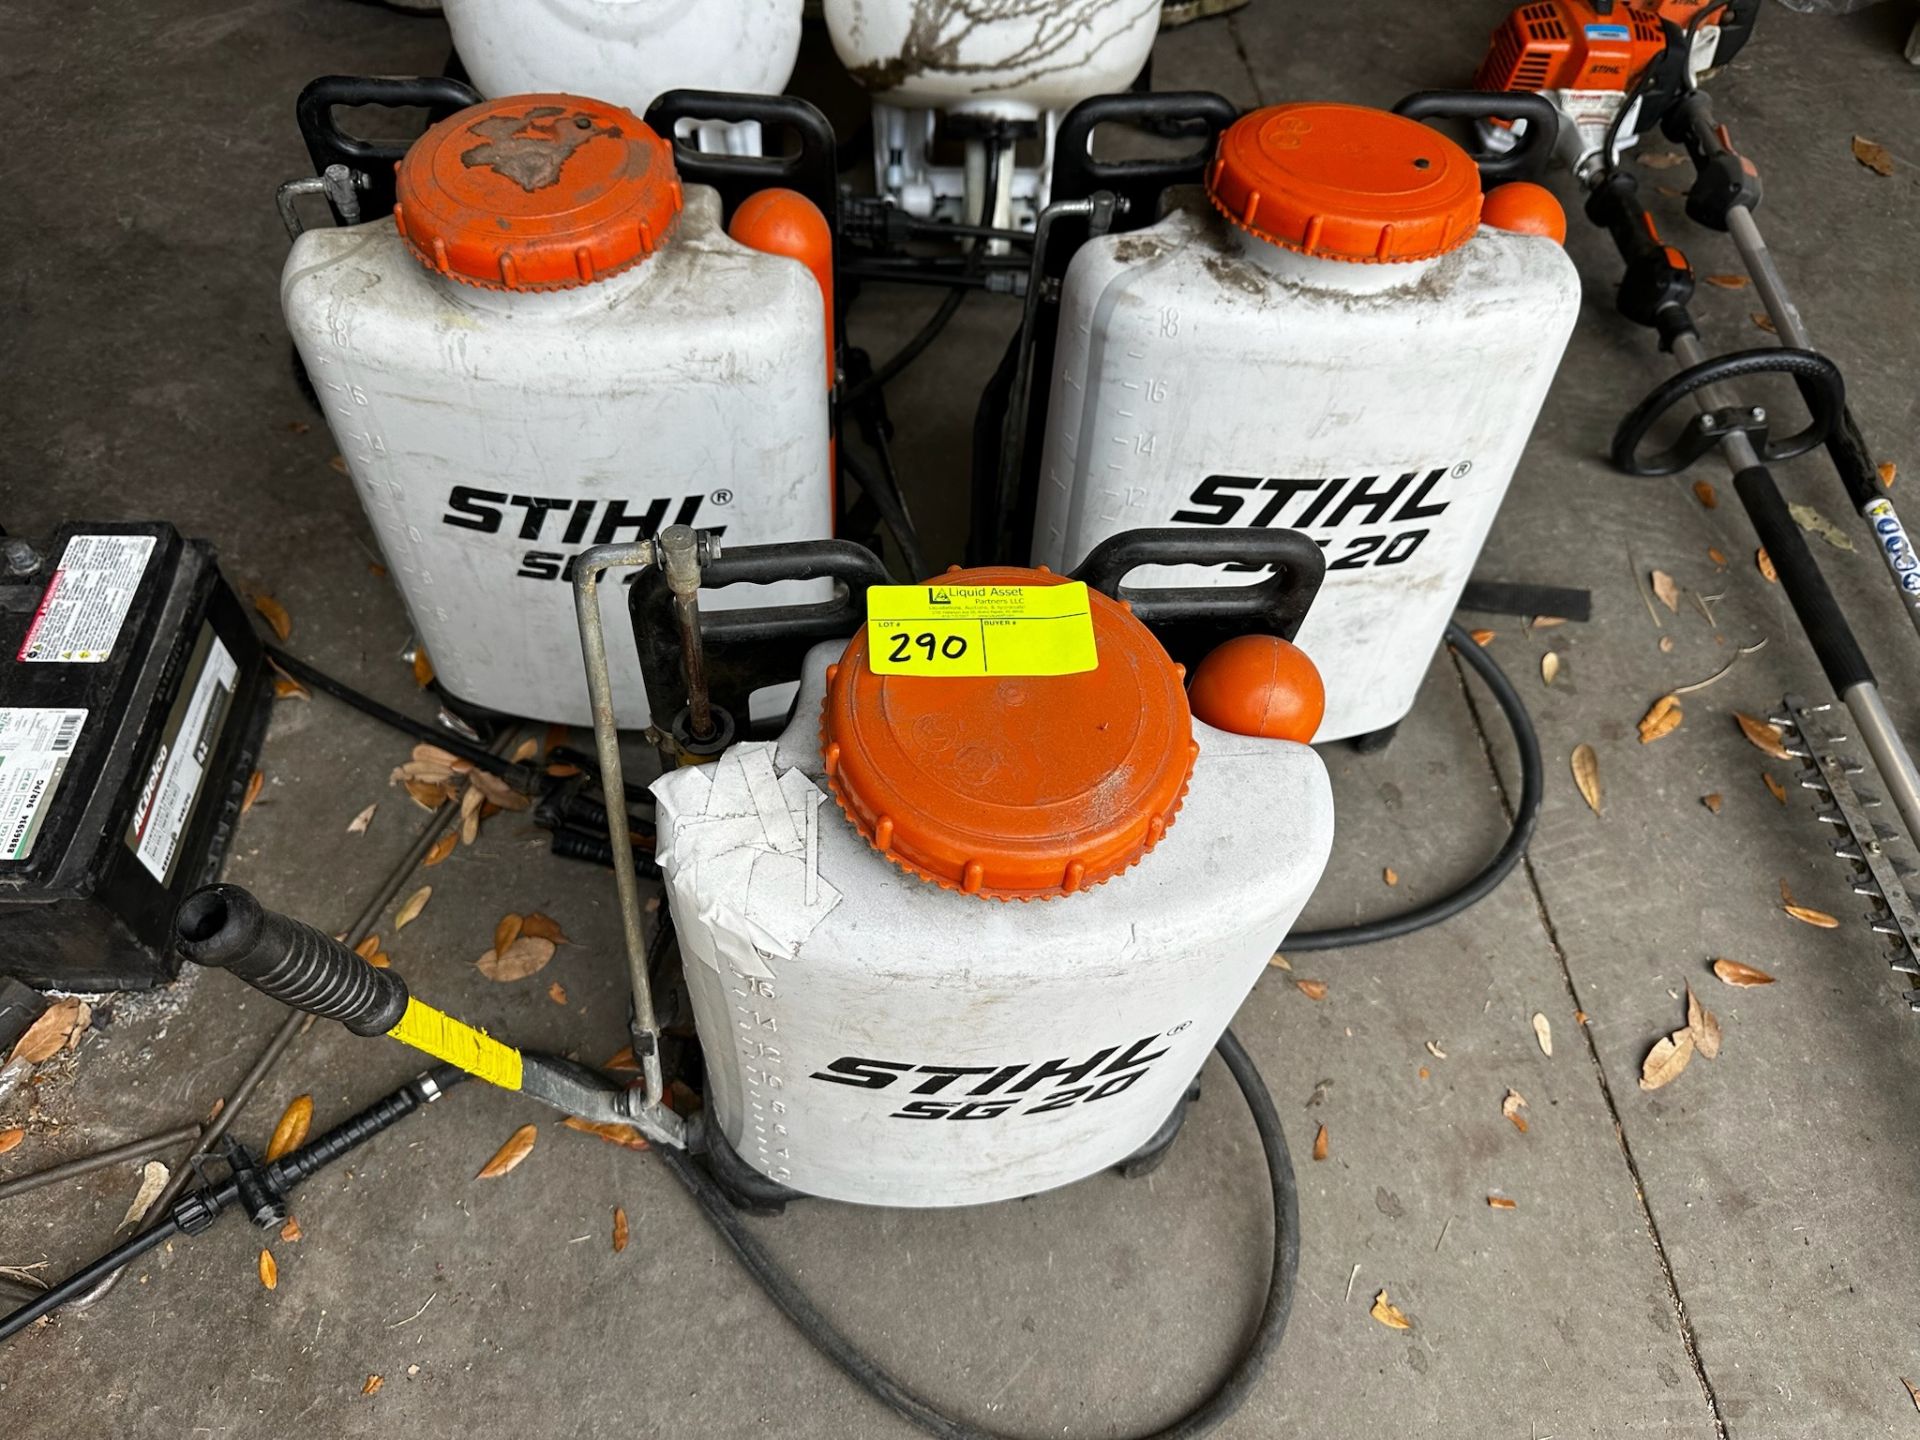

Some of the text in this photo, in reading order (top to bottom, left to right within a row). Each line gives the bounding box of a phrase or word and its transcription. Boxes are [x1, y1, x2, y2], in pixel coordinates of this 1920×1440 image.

[1143, 379, 1167, 402] 16
[1133, 432, 1157, 456] 14
[1326, 529, 1430, 570] 20
[949, 587, 1024, 598] Liquid Asset
[888, 632, 967, 662] 290
[26, 779, 45, 808] 94R/PG
[133, 744, 168, 836] ACDelco
[747, 977, 776, 999] 16
[753, 1011, 778, 1032] 14
[889, 1067, 1150, 1120] SG 20
